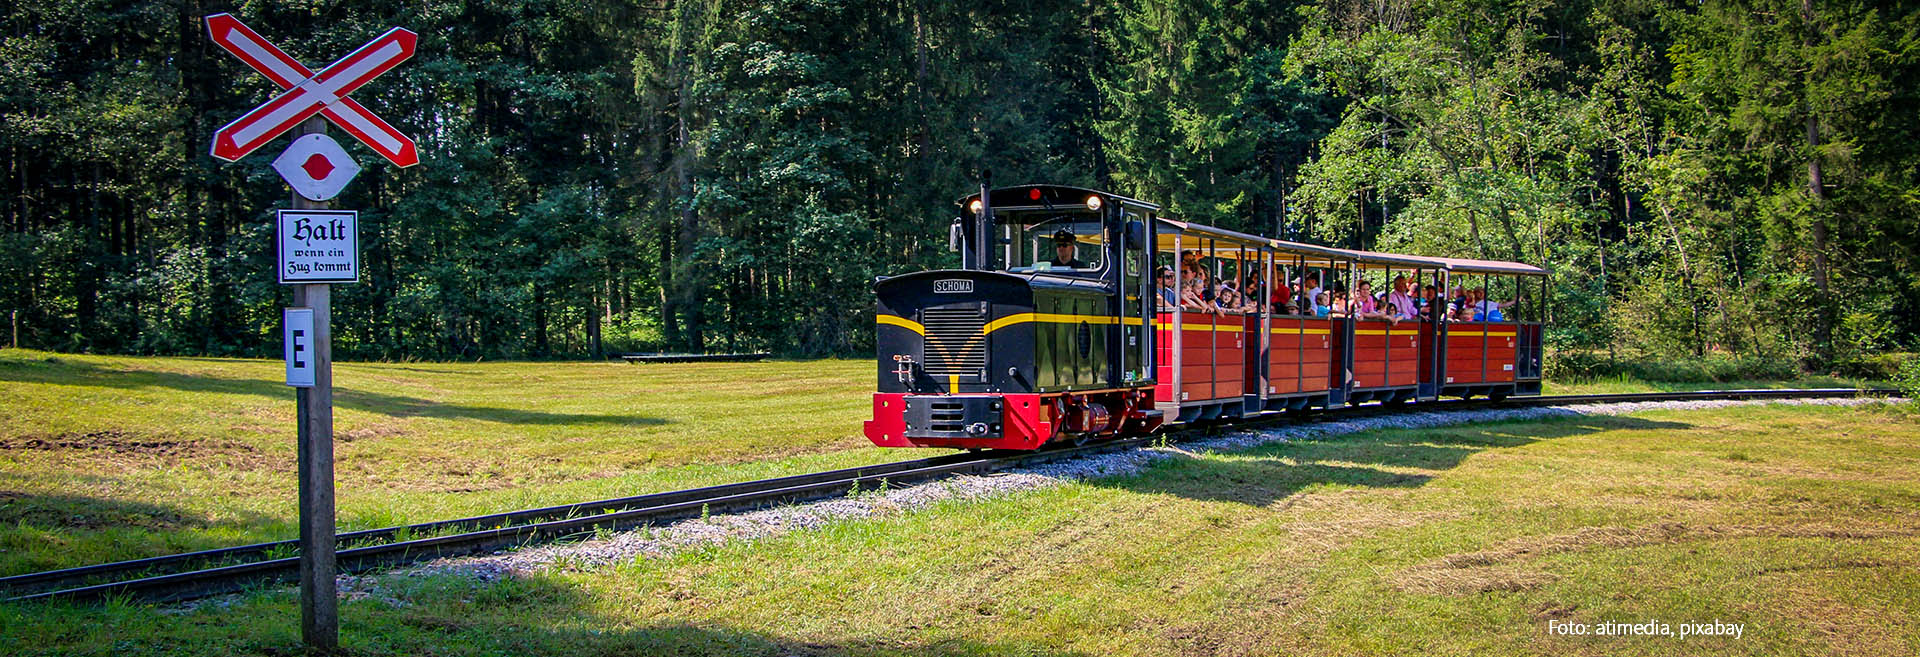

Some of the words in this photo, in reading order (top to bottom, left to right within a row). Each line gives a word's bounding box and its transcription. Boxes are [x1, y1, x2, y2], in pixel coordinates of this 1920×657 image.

[292, 217, 346, 247] Halt
[294, 249, 325, 257] wenn
[328, 247, 345, 257] ein
[288, 261, 311, 275] Zug
[314, 261, 351, 272] kommt
[293, 329, 305, 368] E
